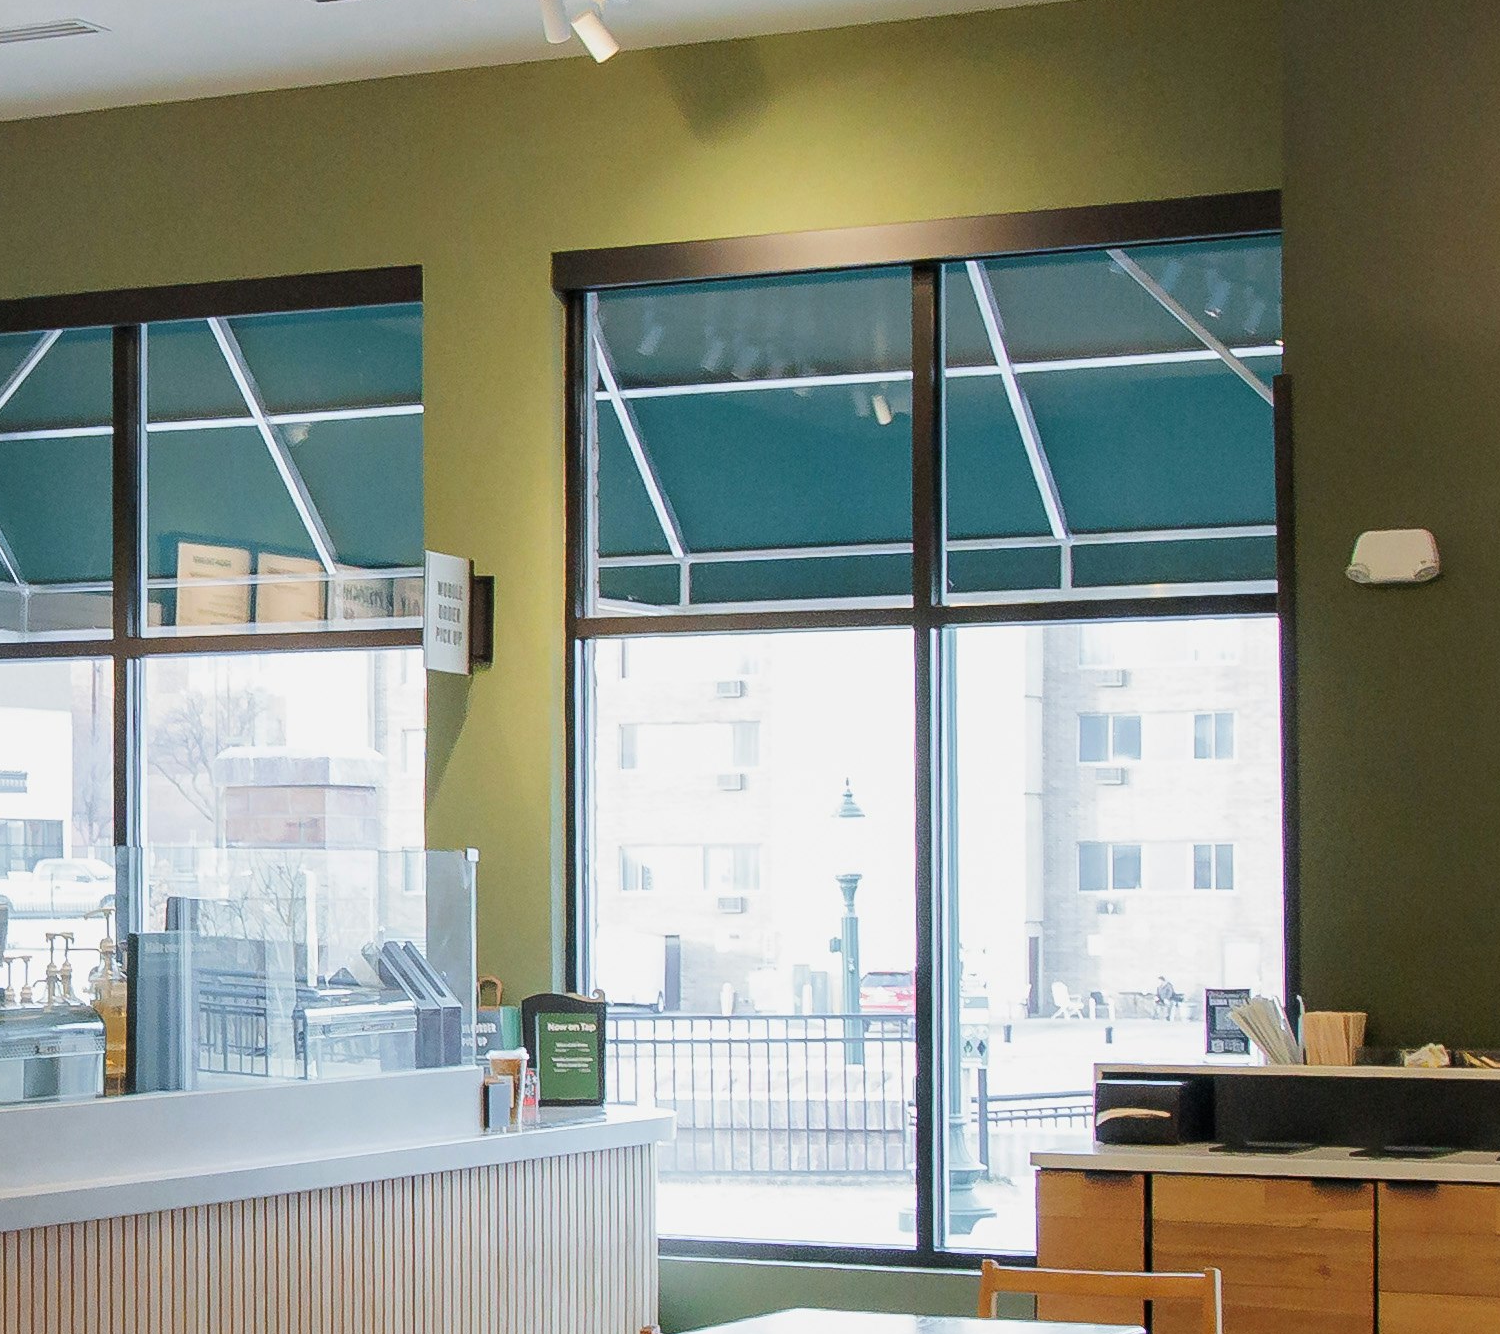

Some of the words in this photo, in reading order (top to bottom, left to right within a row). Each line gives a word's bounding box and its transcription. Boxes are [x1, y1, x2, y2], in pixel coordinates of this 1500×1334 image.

[437, 580, 463, 602] MOBILE
[438, 603, 461, 624] ORDER
[435, 625, 451, 645] PICK
[452, 630, 463, 647] UP
[547, 1022, 567, 1032] Now
[567, 1024, 580, 1032] on
[580, 1022, 597, 1033] Tap
